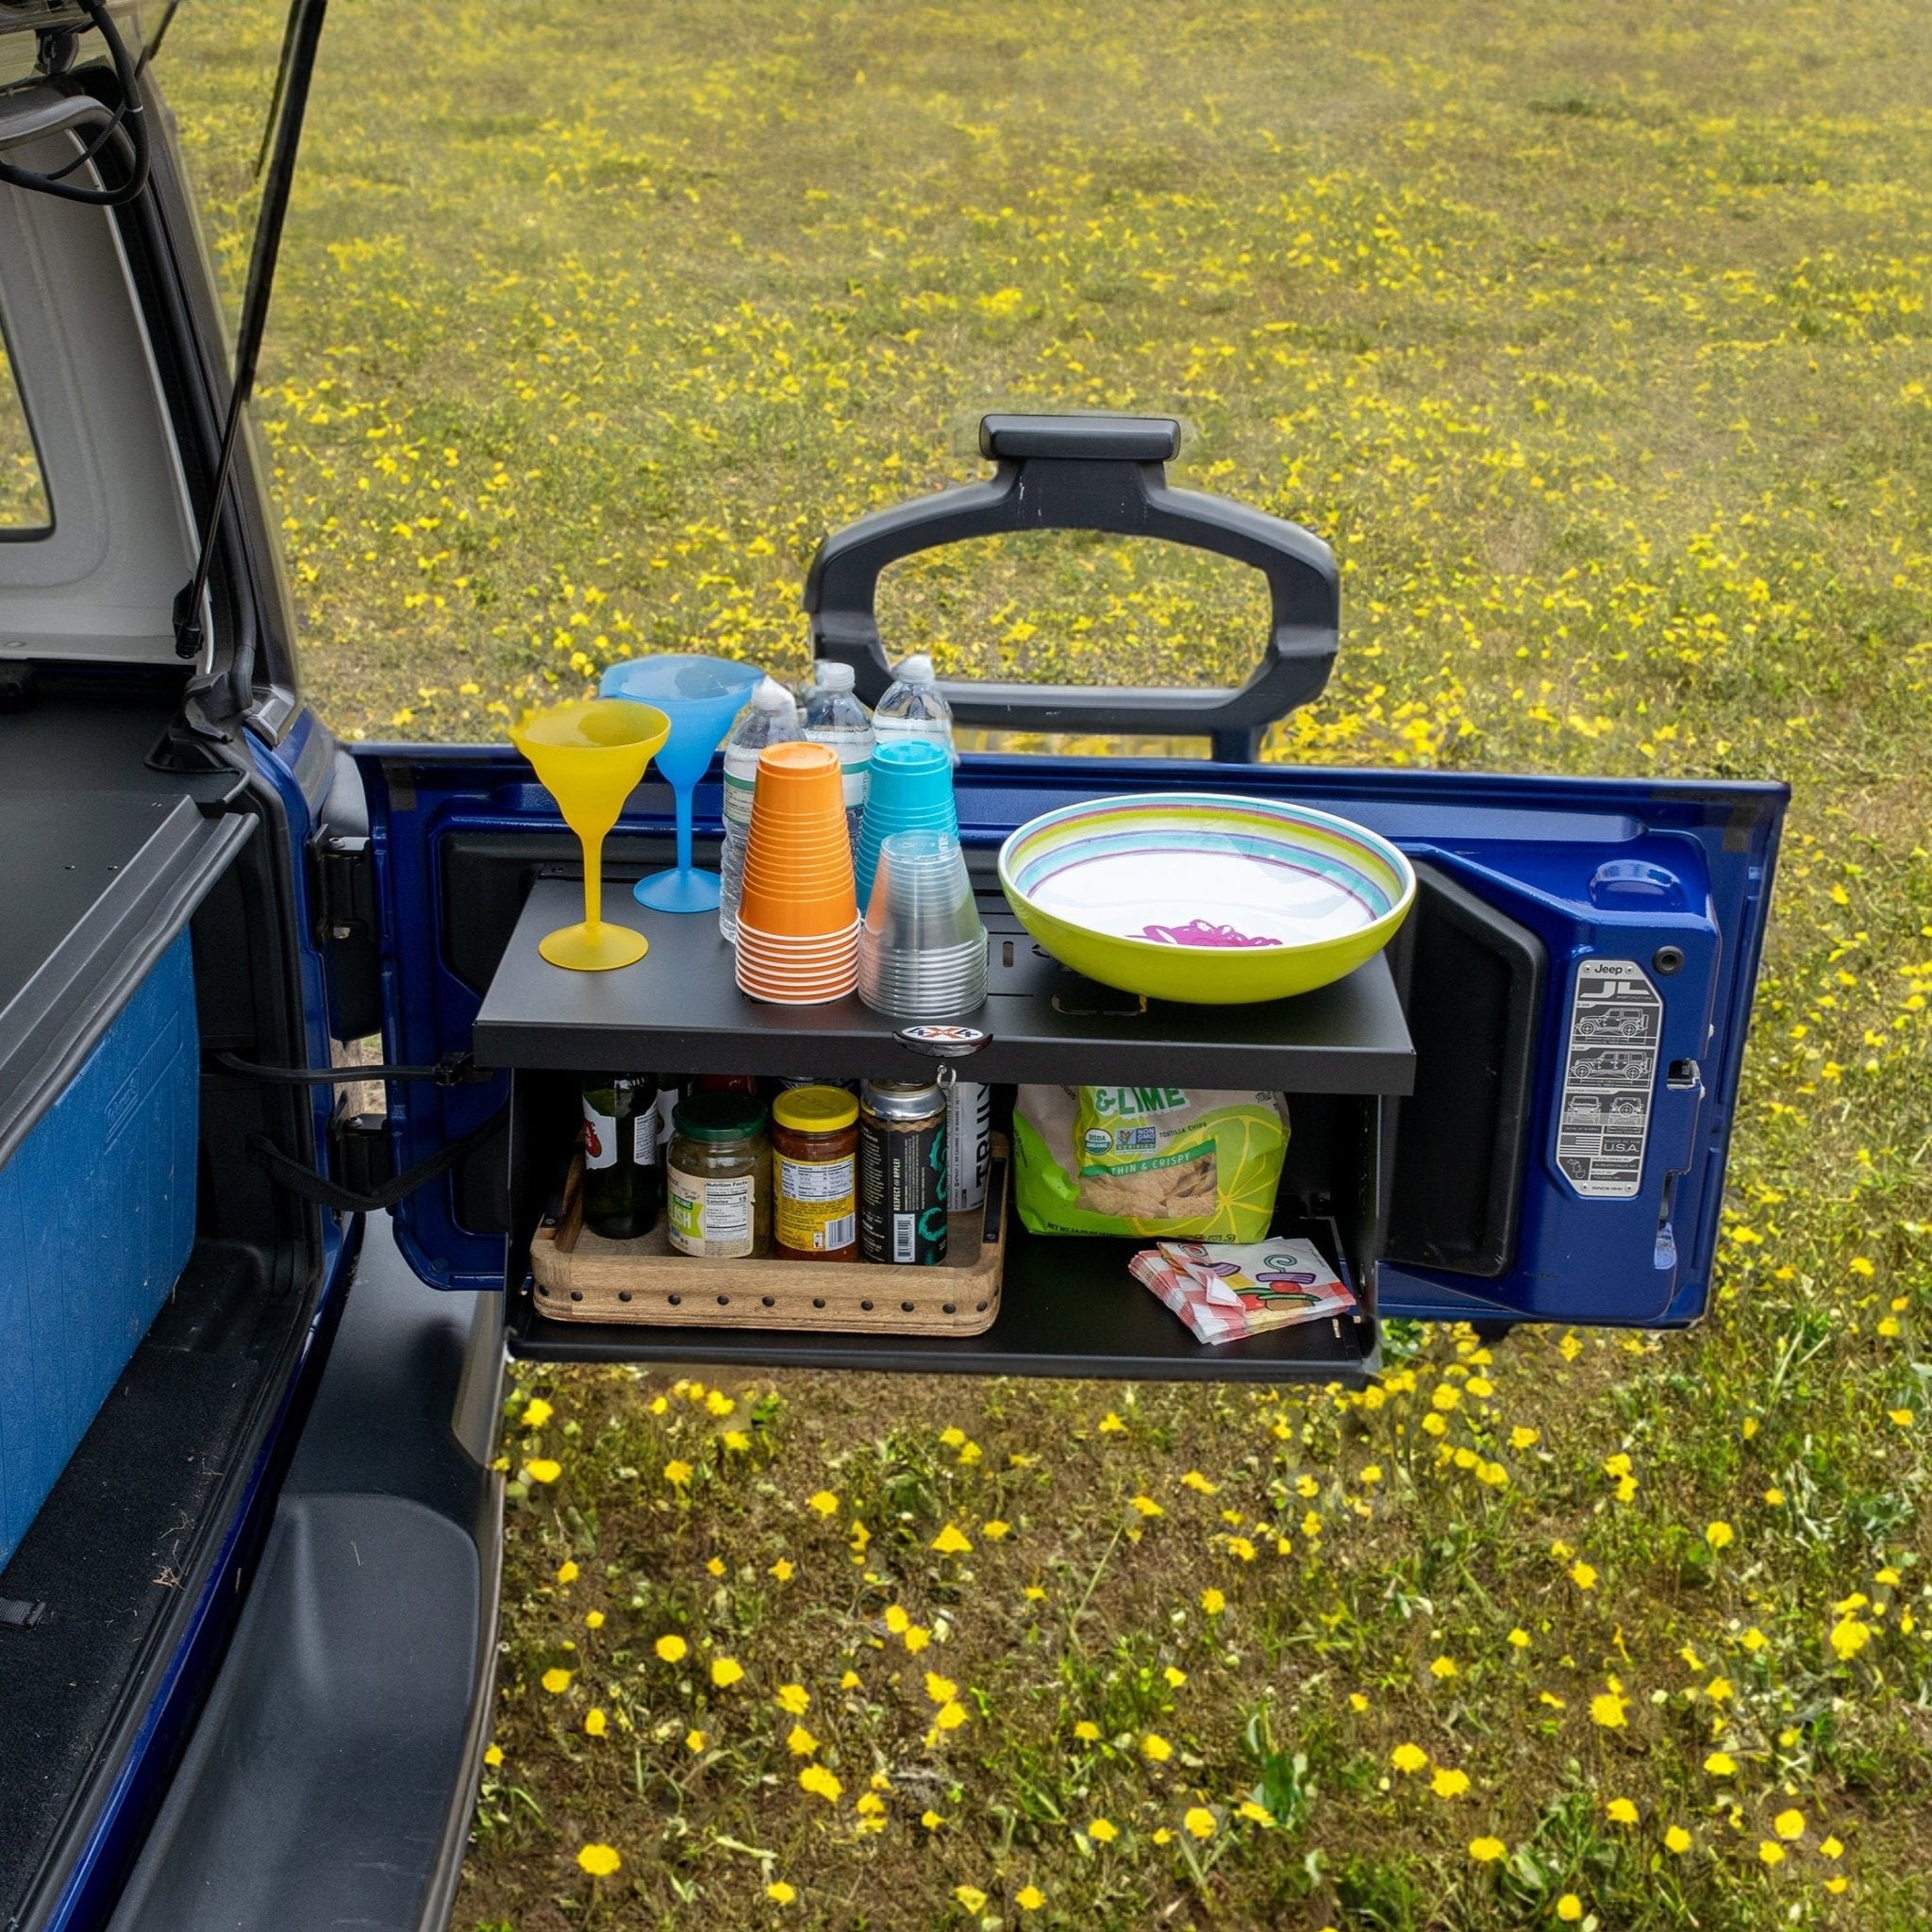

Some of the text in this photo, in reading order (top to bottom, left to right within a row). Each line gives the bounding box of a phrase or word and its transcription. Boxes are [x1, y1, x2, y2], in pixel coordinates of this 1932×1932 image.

[1594, 964, 1623, 975] Jeep
[1579, 981, 1650, 998] JL
[1118, 1086, 1186, 1114] LIME
[1158, 1122, 1208, 1138] TORTILLA CHIPS
[1603, 1143, 1641, 1153] U.S.A.
[892, 1158, 901, 1178] APPLE!
[1110, 1165, 1137, 1176] THIN
[1153, 1152, 1191, 1168] CRISPY
[892, 1187, 901, 1211] RESPECT
[670, 1204, 691, 1230] LISH
